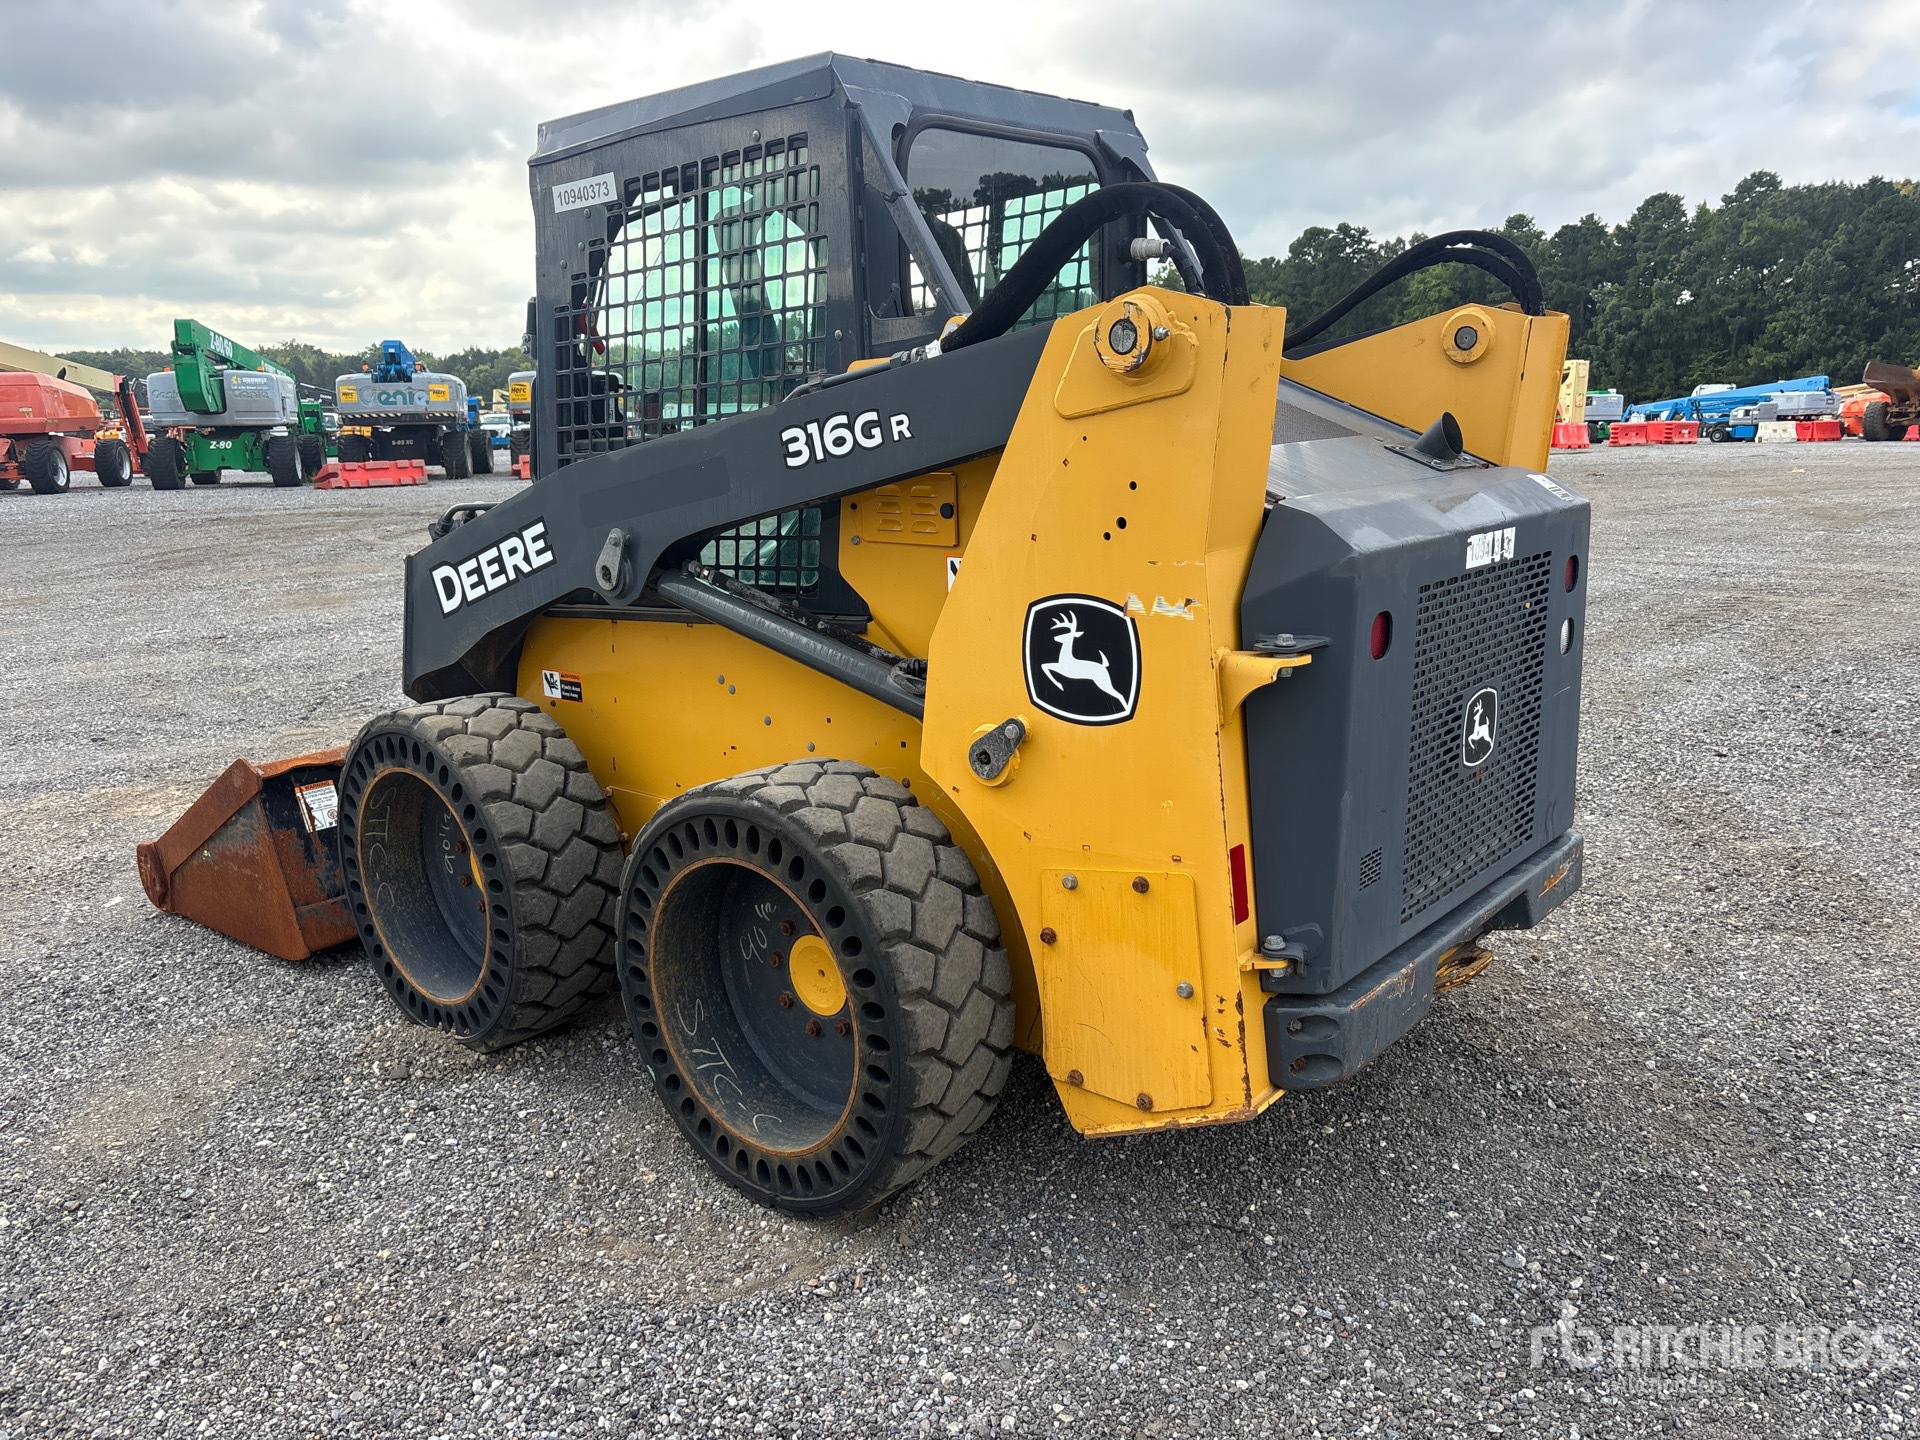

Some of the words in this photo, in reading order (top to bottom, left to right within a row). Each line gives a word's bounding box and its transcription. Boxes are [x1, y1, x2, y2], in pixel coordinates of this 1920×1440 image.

[557, 181, 610, 207] 10940373
[511, 386, 527, 394] Herc
[209, 440, 233, 449] Z-80
[781, 411, 883, 467] 316G
[889, 413, 912, 441] R
[431, 521, 554, 614] DEERE
[304, 781, 330, 790] WARNING
